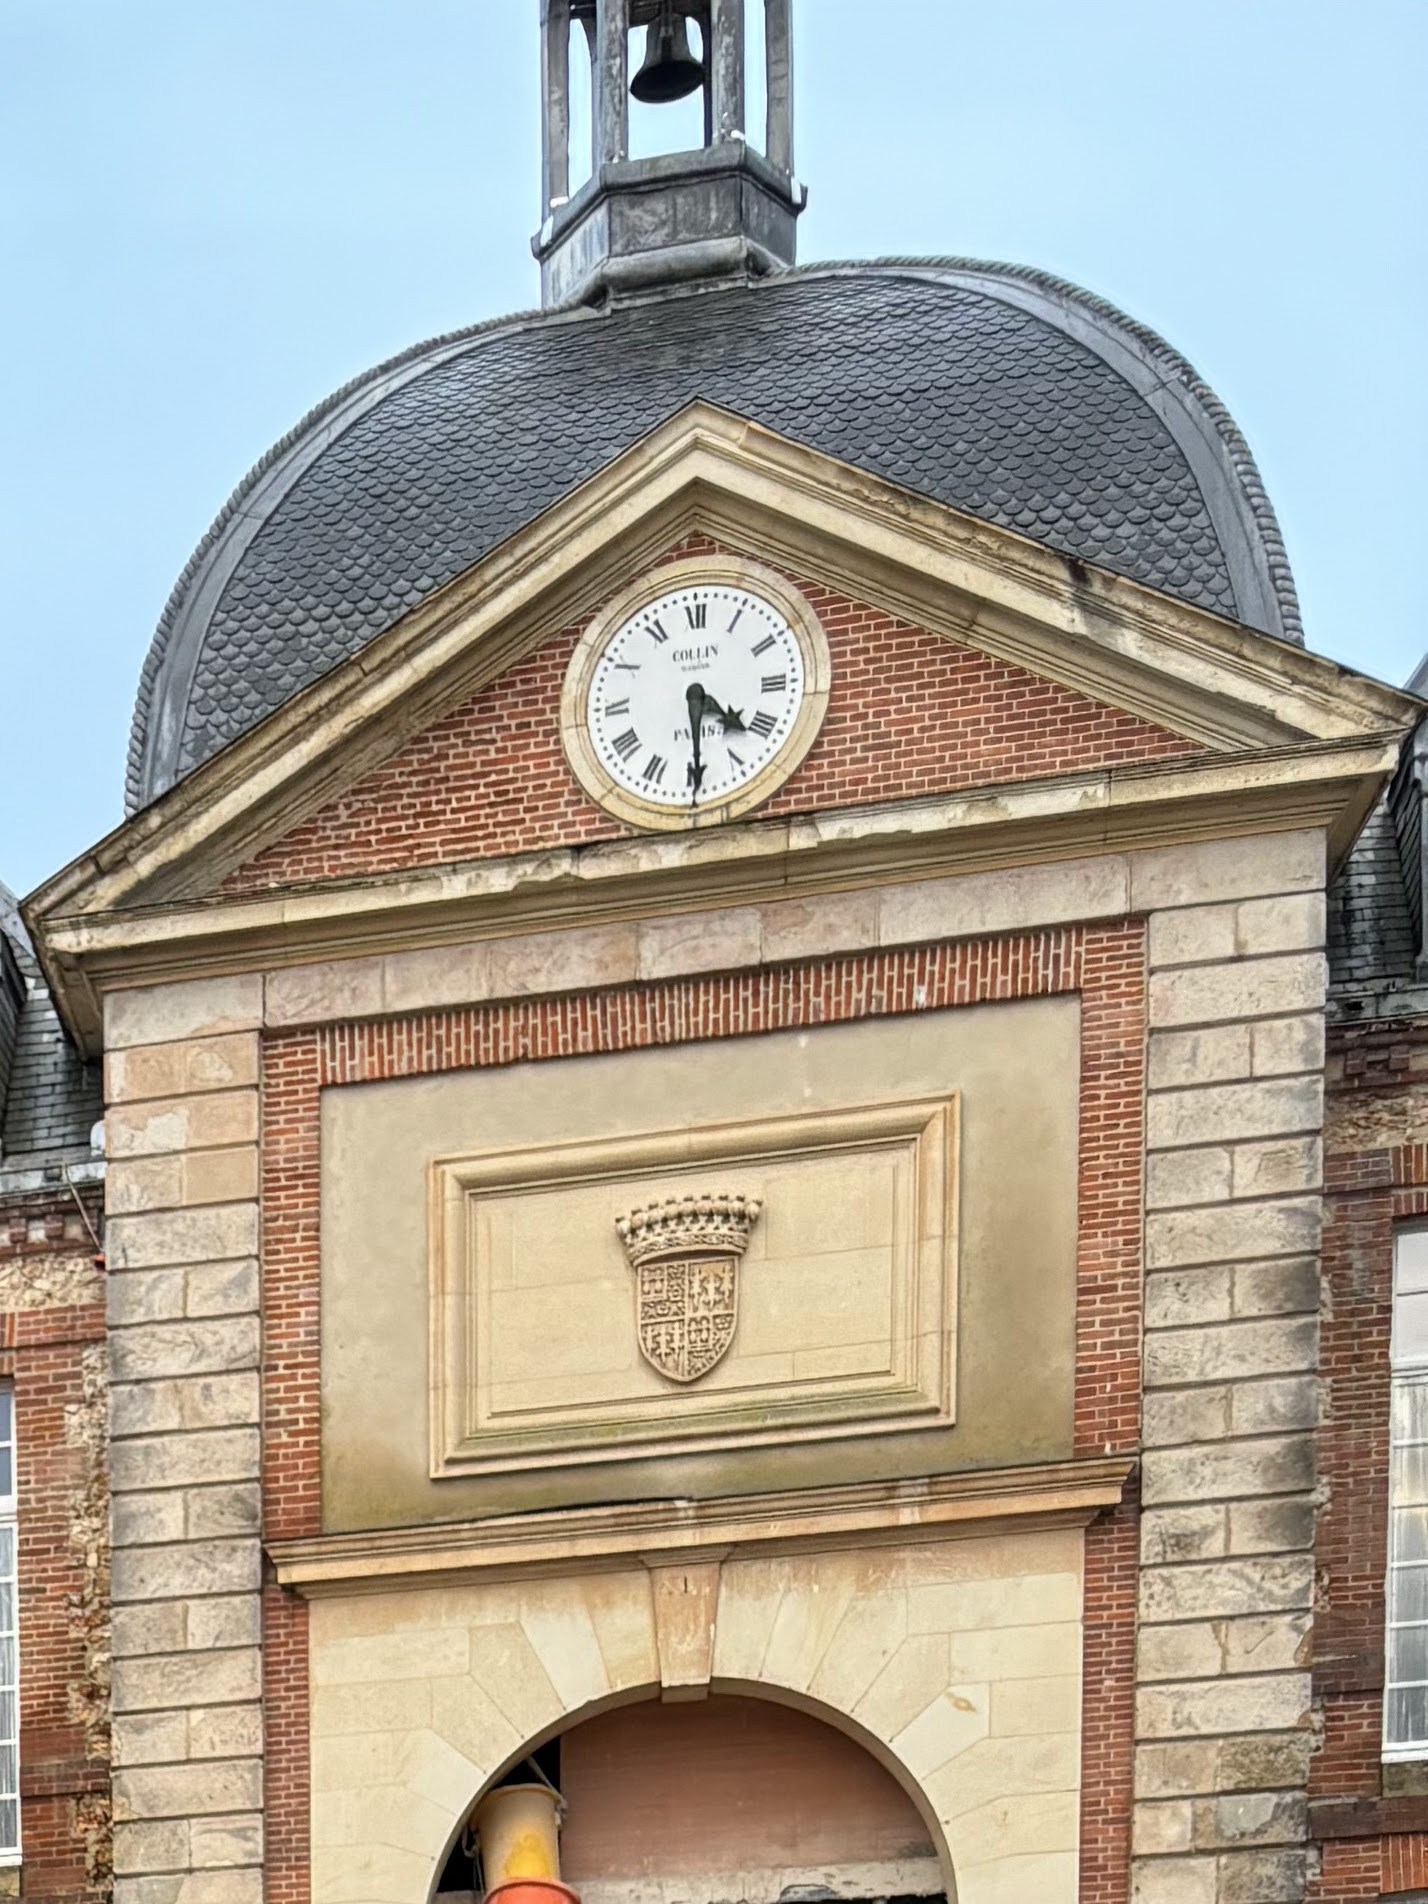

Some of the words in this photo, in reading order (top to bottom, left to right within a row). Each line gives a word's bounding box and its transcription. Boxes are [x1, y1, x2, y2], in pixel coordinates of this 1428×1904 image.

[727, 609, 743, 634] I
[672, 645, 719, 663] COLLIN
[750, 633, 777, 658] II
[761, 673, 786, 693] III
